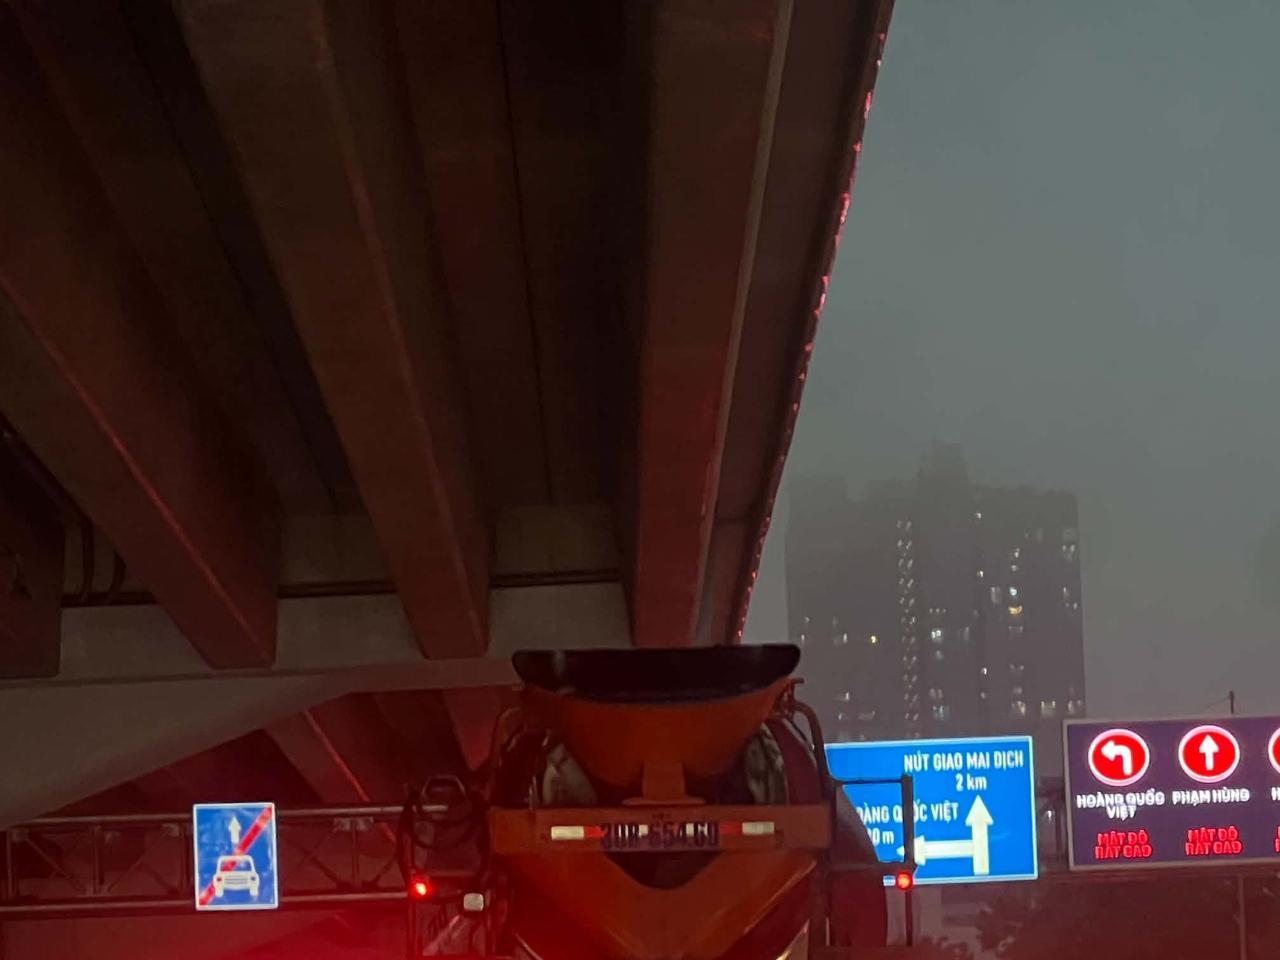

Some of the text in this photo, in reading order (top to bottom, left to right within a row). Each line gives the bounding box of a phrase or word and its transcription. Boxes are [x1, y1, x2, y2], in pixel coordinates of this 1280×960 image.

[904, 750, 1023, 771] NÚT GIAO MAI DỊCH
[955, 773, 987, 791] 2 km
[1076, 788, 1165, 808] HOÀNG QUỐC
[1172, 787, 1250, 806] PHẠM HÙNG
[857, 802, 889, 824] OÀNG
[930, 800, 959, 823] VIỆT
[1105, 803, 1137, 821] VIỆT
[882, 831, 894, 844] m
